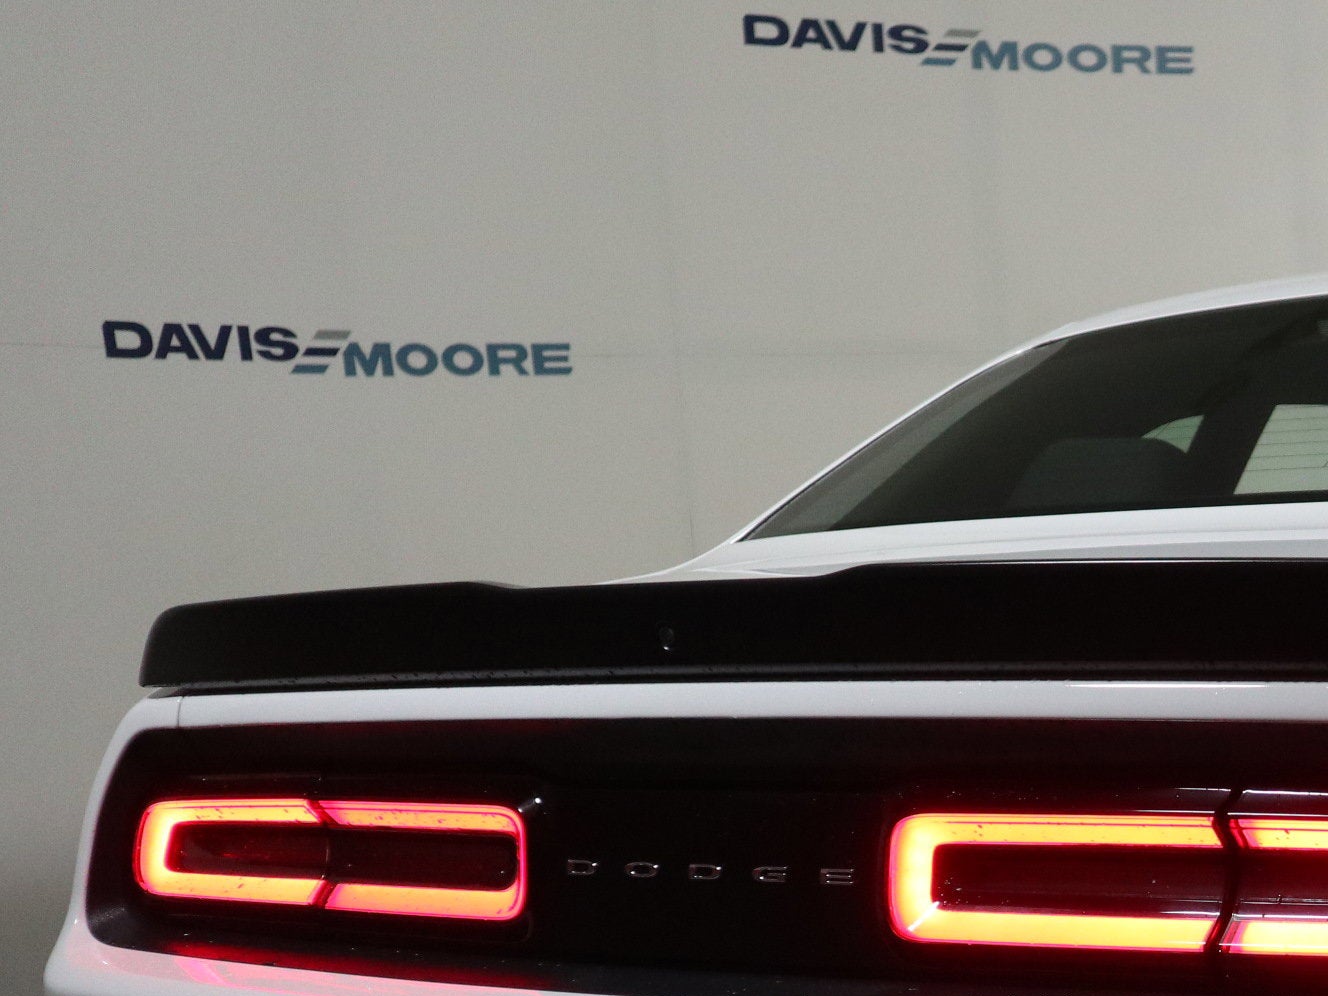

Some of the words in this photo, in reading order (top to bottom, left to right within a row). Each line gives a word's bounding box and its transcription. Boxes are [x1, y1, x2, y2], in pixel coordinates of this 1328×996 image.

[742, 14, 929, 55] DAVIS
[970, 40, 1195, 76] MOORE
[102, 320, 301, 362] DAVIS
[343, 342, 573, 377] MOORE
[567, 858, 855, 886] DODGE
